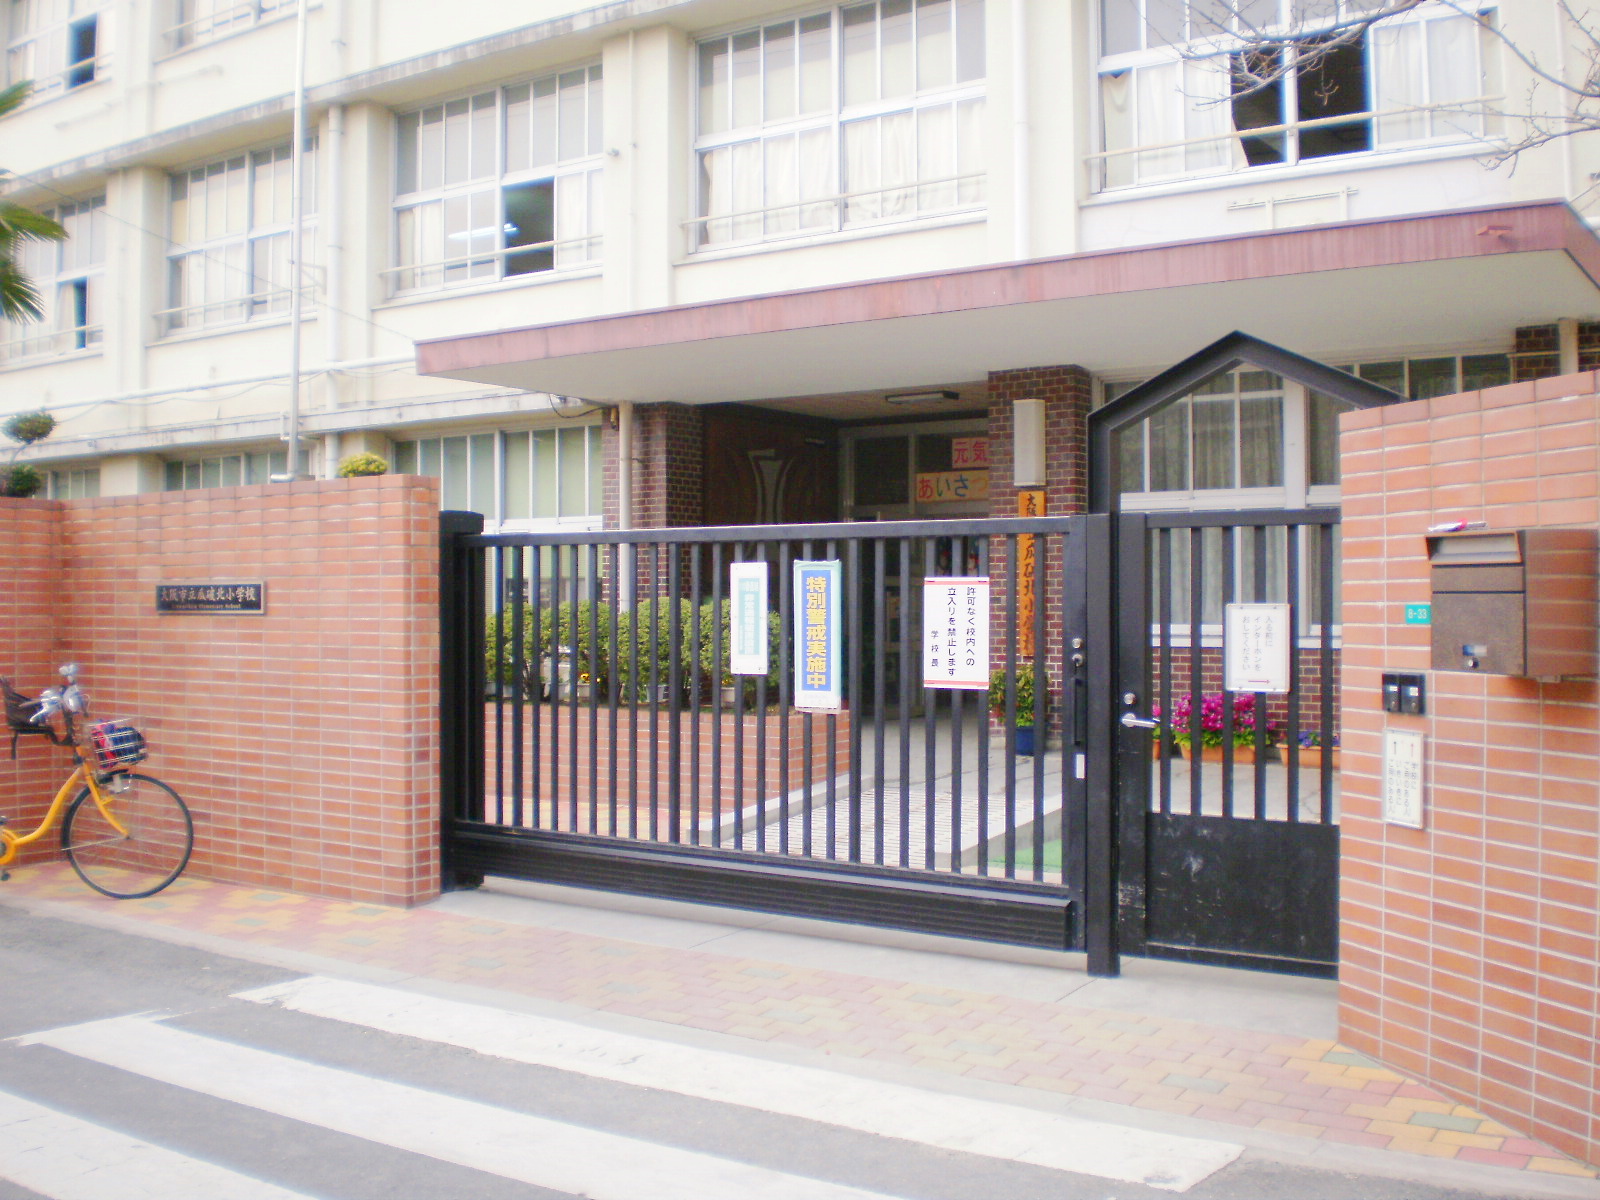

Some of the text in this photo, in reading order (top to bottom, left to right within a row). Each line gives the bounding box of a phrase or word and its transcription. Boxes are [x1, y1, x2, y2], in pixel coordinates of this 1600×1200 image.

[918, 474, 988, 499] あいさつ
[806, 576, 827, 689] 特別警戒実施中
[947, 587, 957, 677] 立入りを禁止します
[966, 586, 976, 666] 許可なく校内への
[1408, 608, 1427, 619] 8-33
